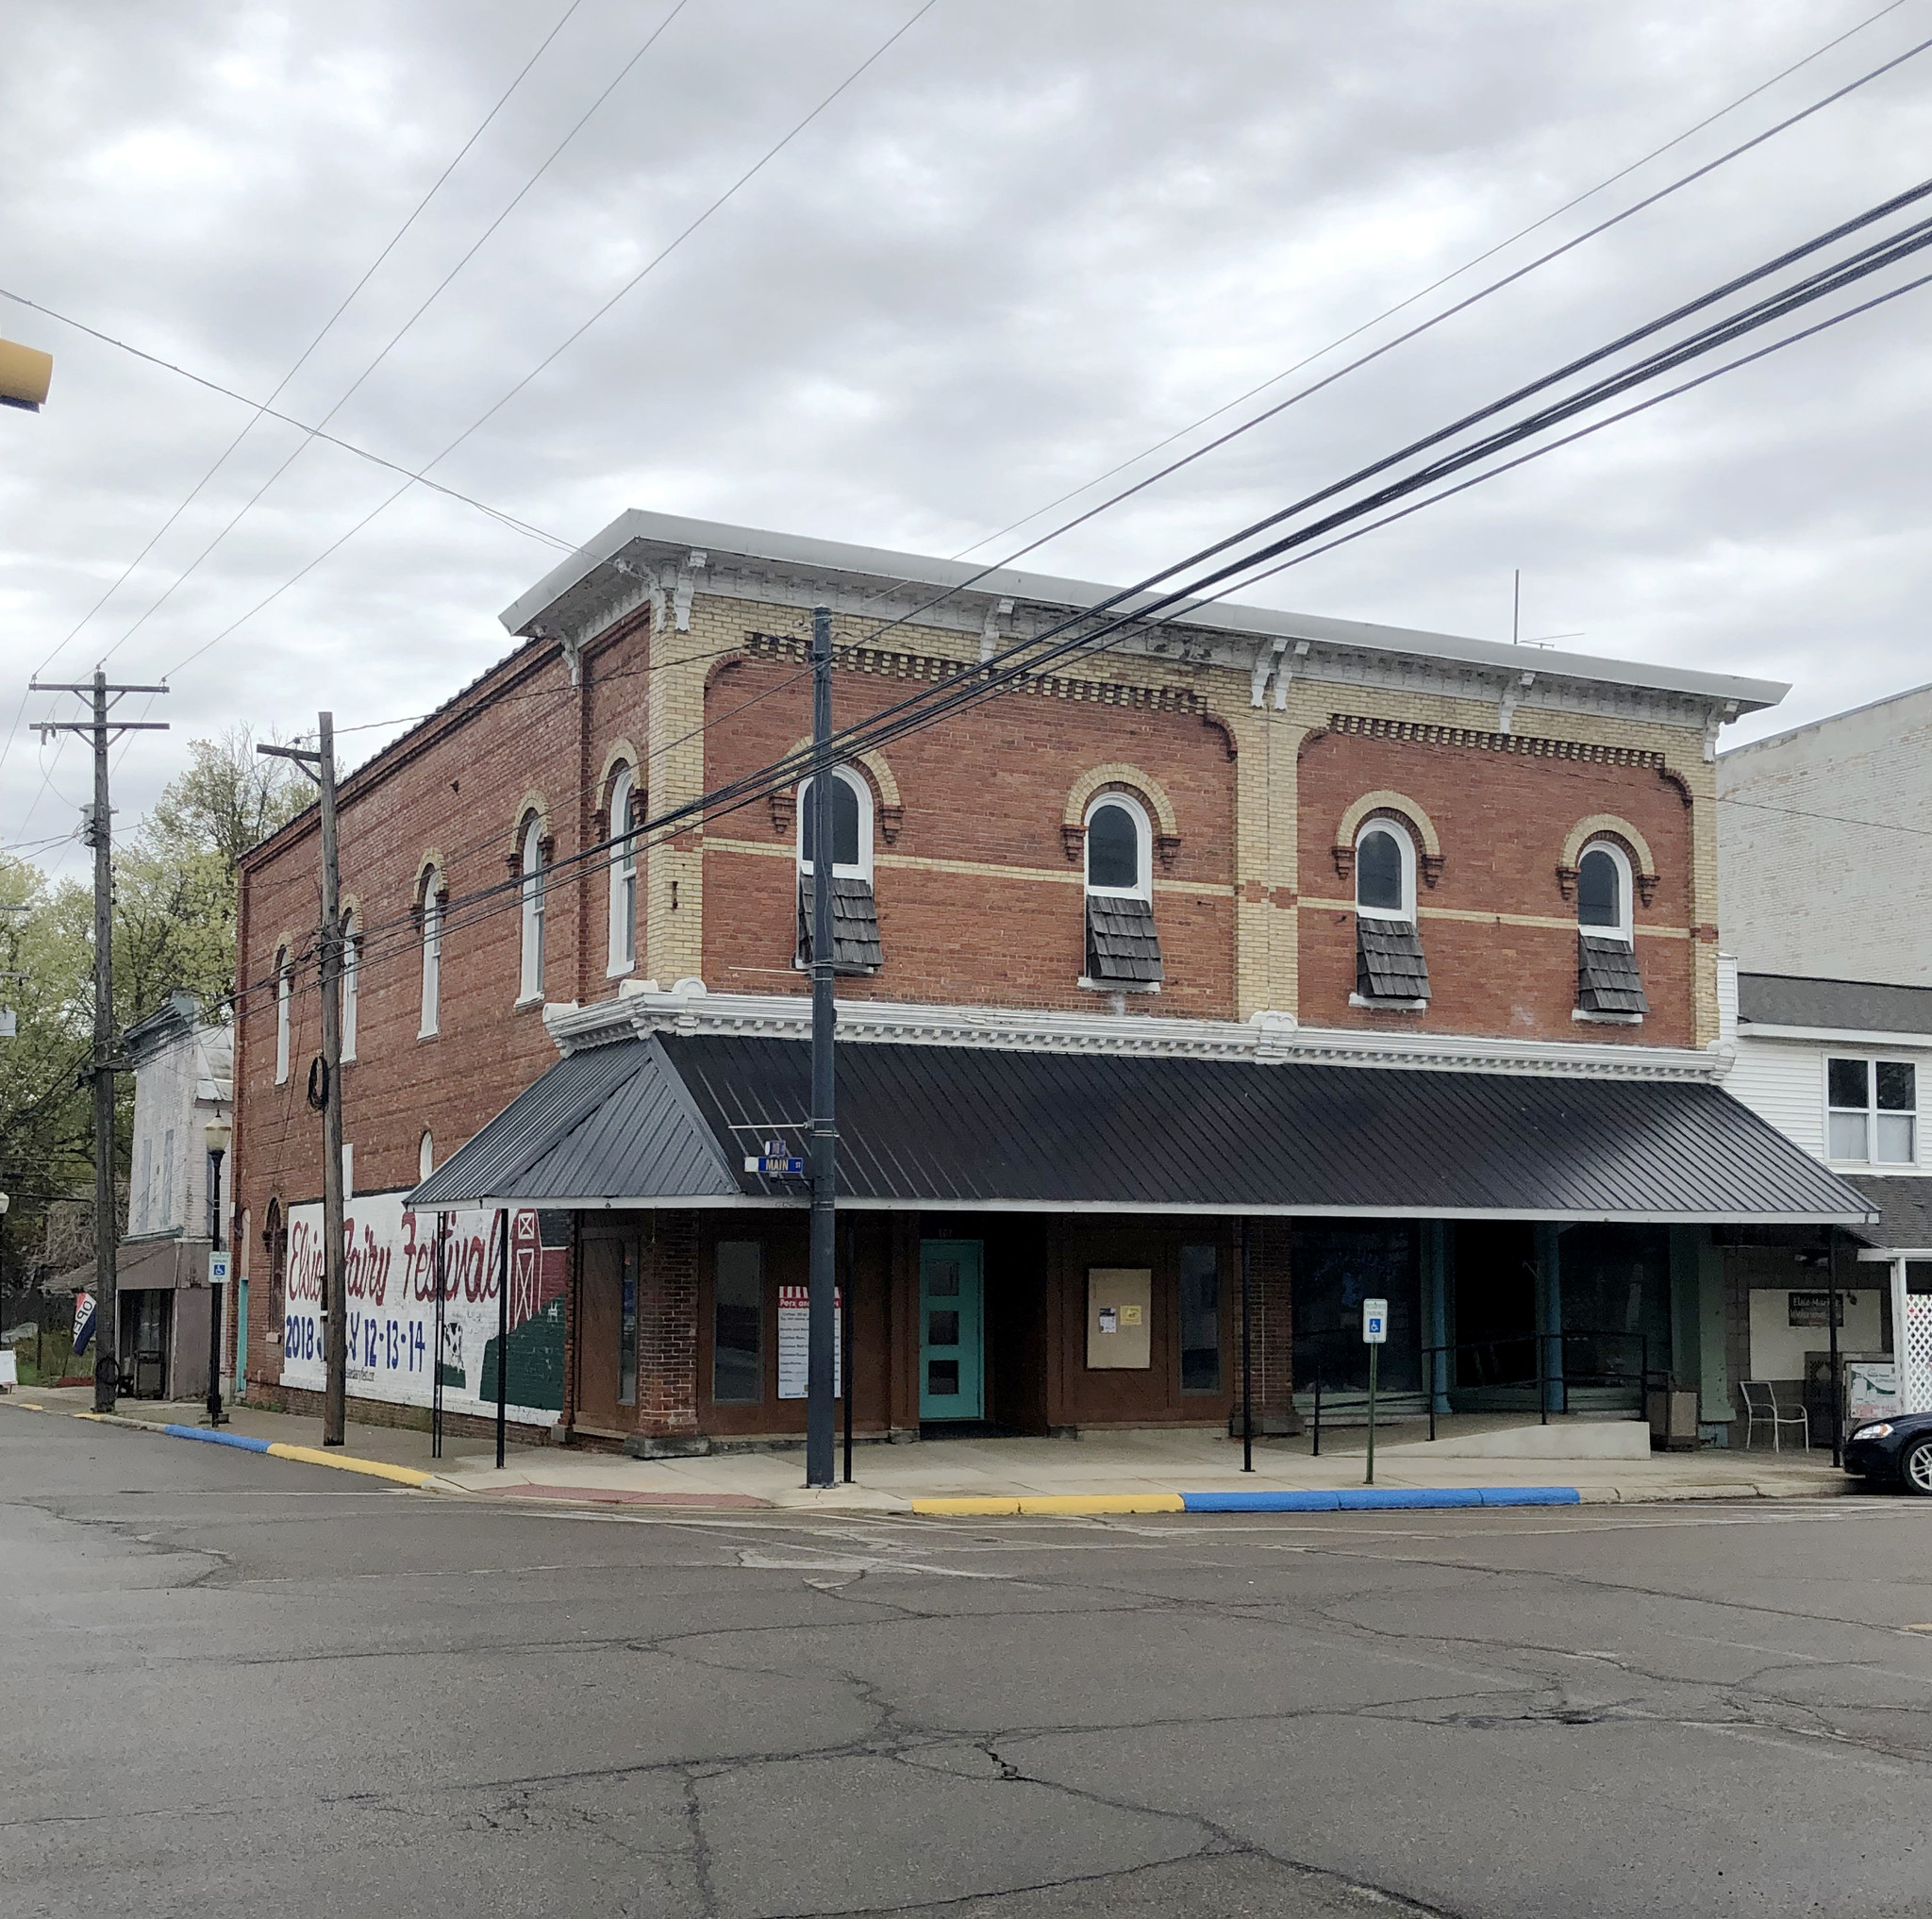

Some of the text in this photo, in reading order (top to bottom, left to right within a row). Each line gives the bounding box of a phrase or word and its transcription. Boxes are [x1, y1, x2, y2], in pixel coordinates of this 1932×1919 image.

[765, 1159, 789, 1171] MAIN
[289, 1219, 325, 1302] Elsie
[401, 1208, 502, 1303] Festival
[73, 1299, 93, 1336] OPE
[285, 1314, 314, 1360] 2018
